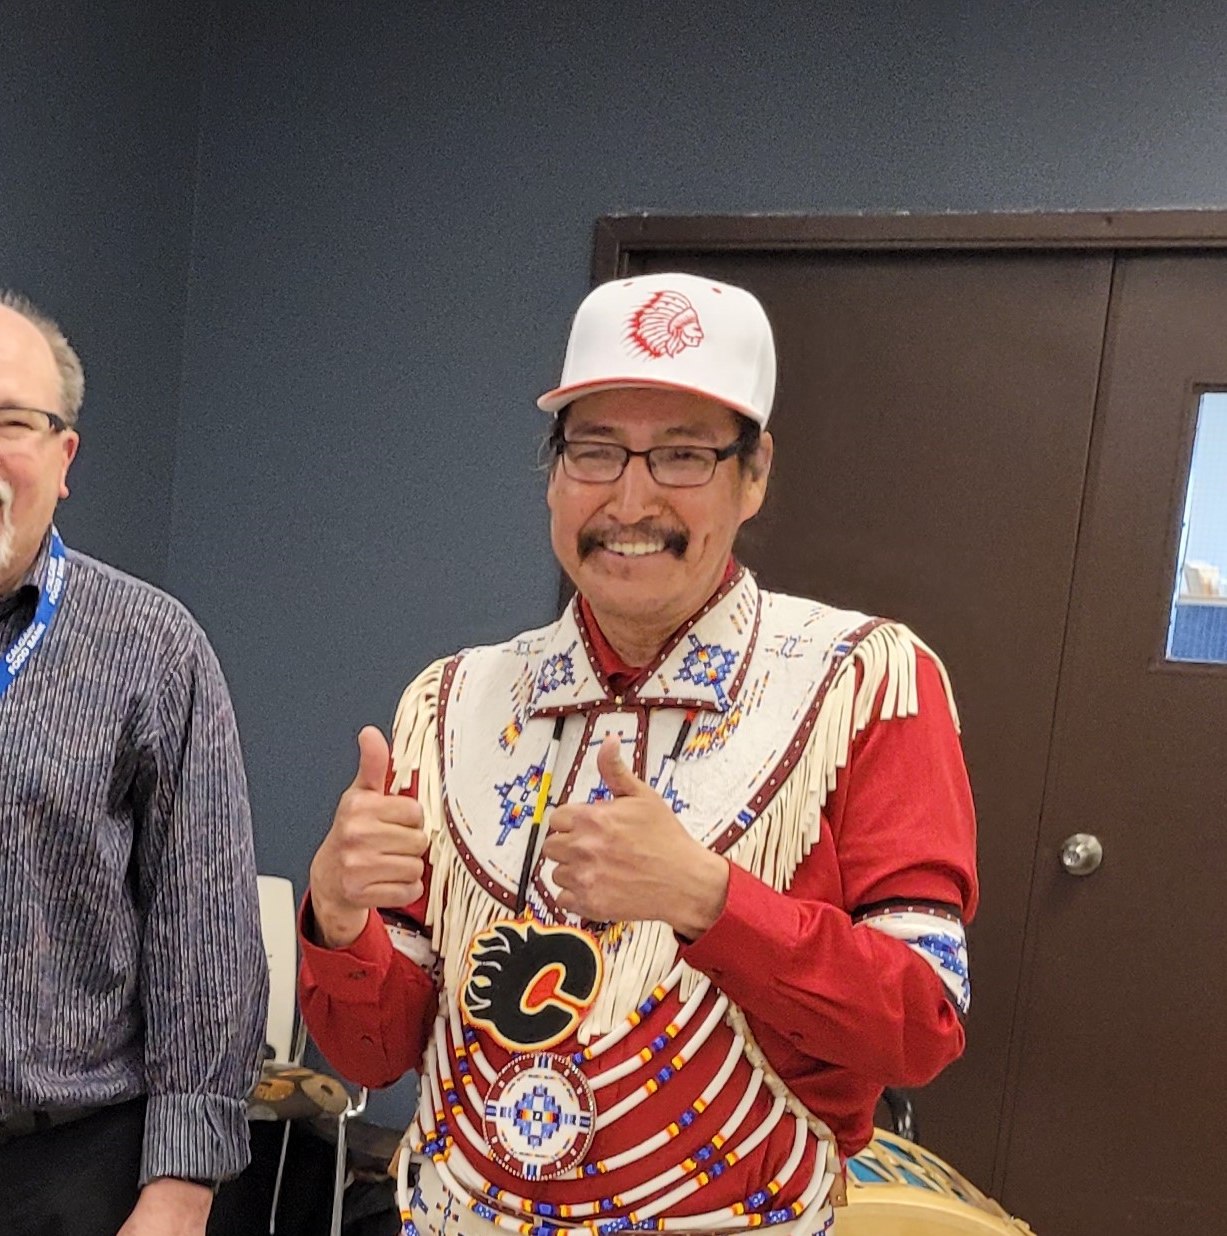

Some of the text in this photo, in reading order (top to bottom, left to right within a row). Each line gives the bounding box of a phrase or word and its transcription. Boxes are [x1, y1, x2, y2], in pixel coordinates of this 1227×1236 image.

[5, 622, 35, 663] CALGARY
[8, 621, 47, 675] FOOD BANK
